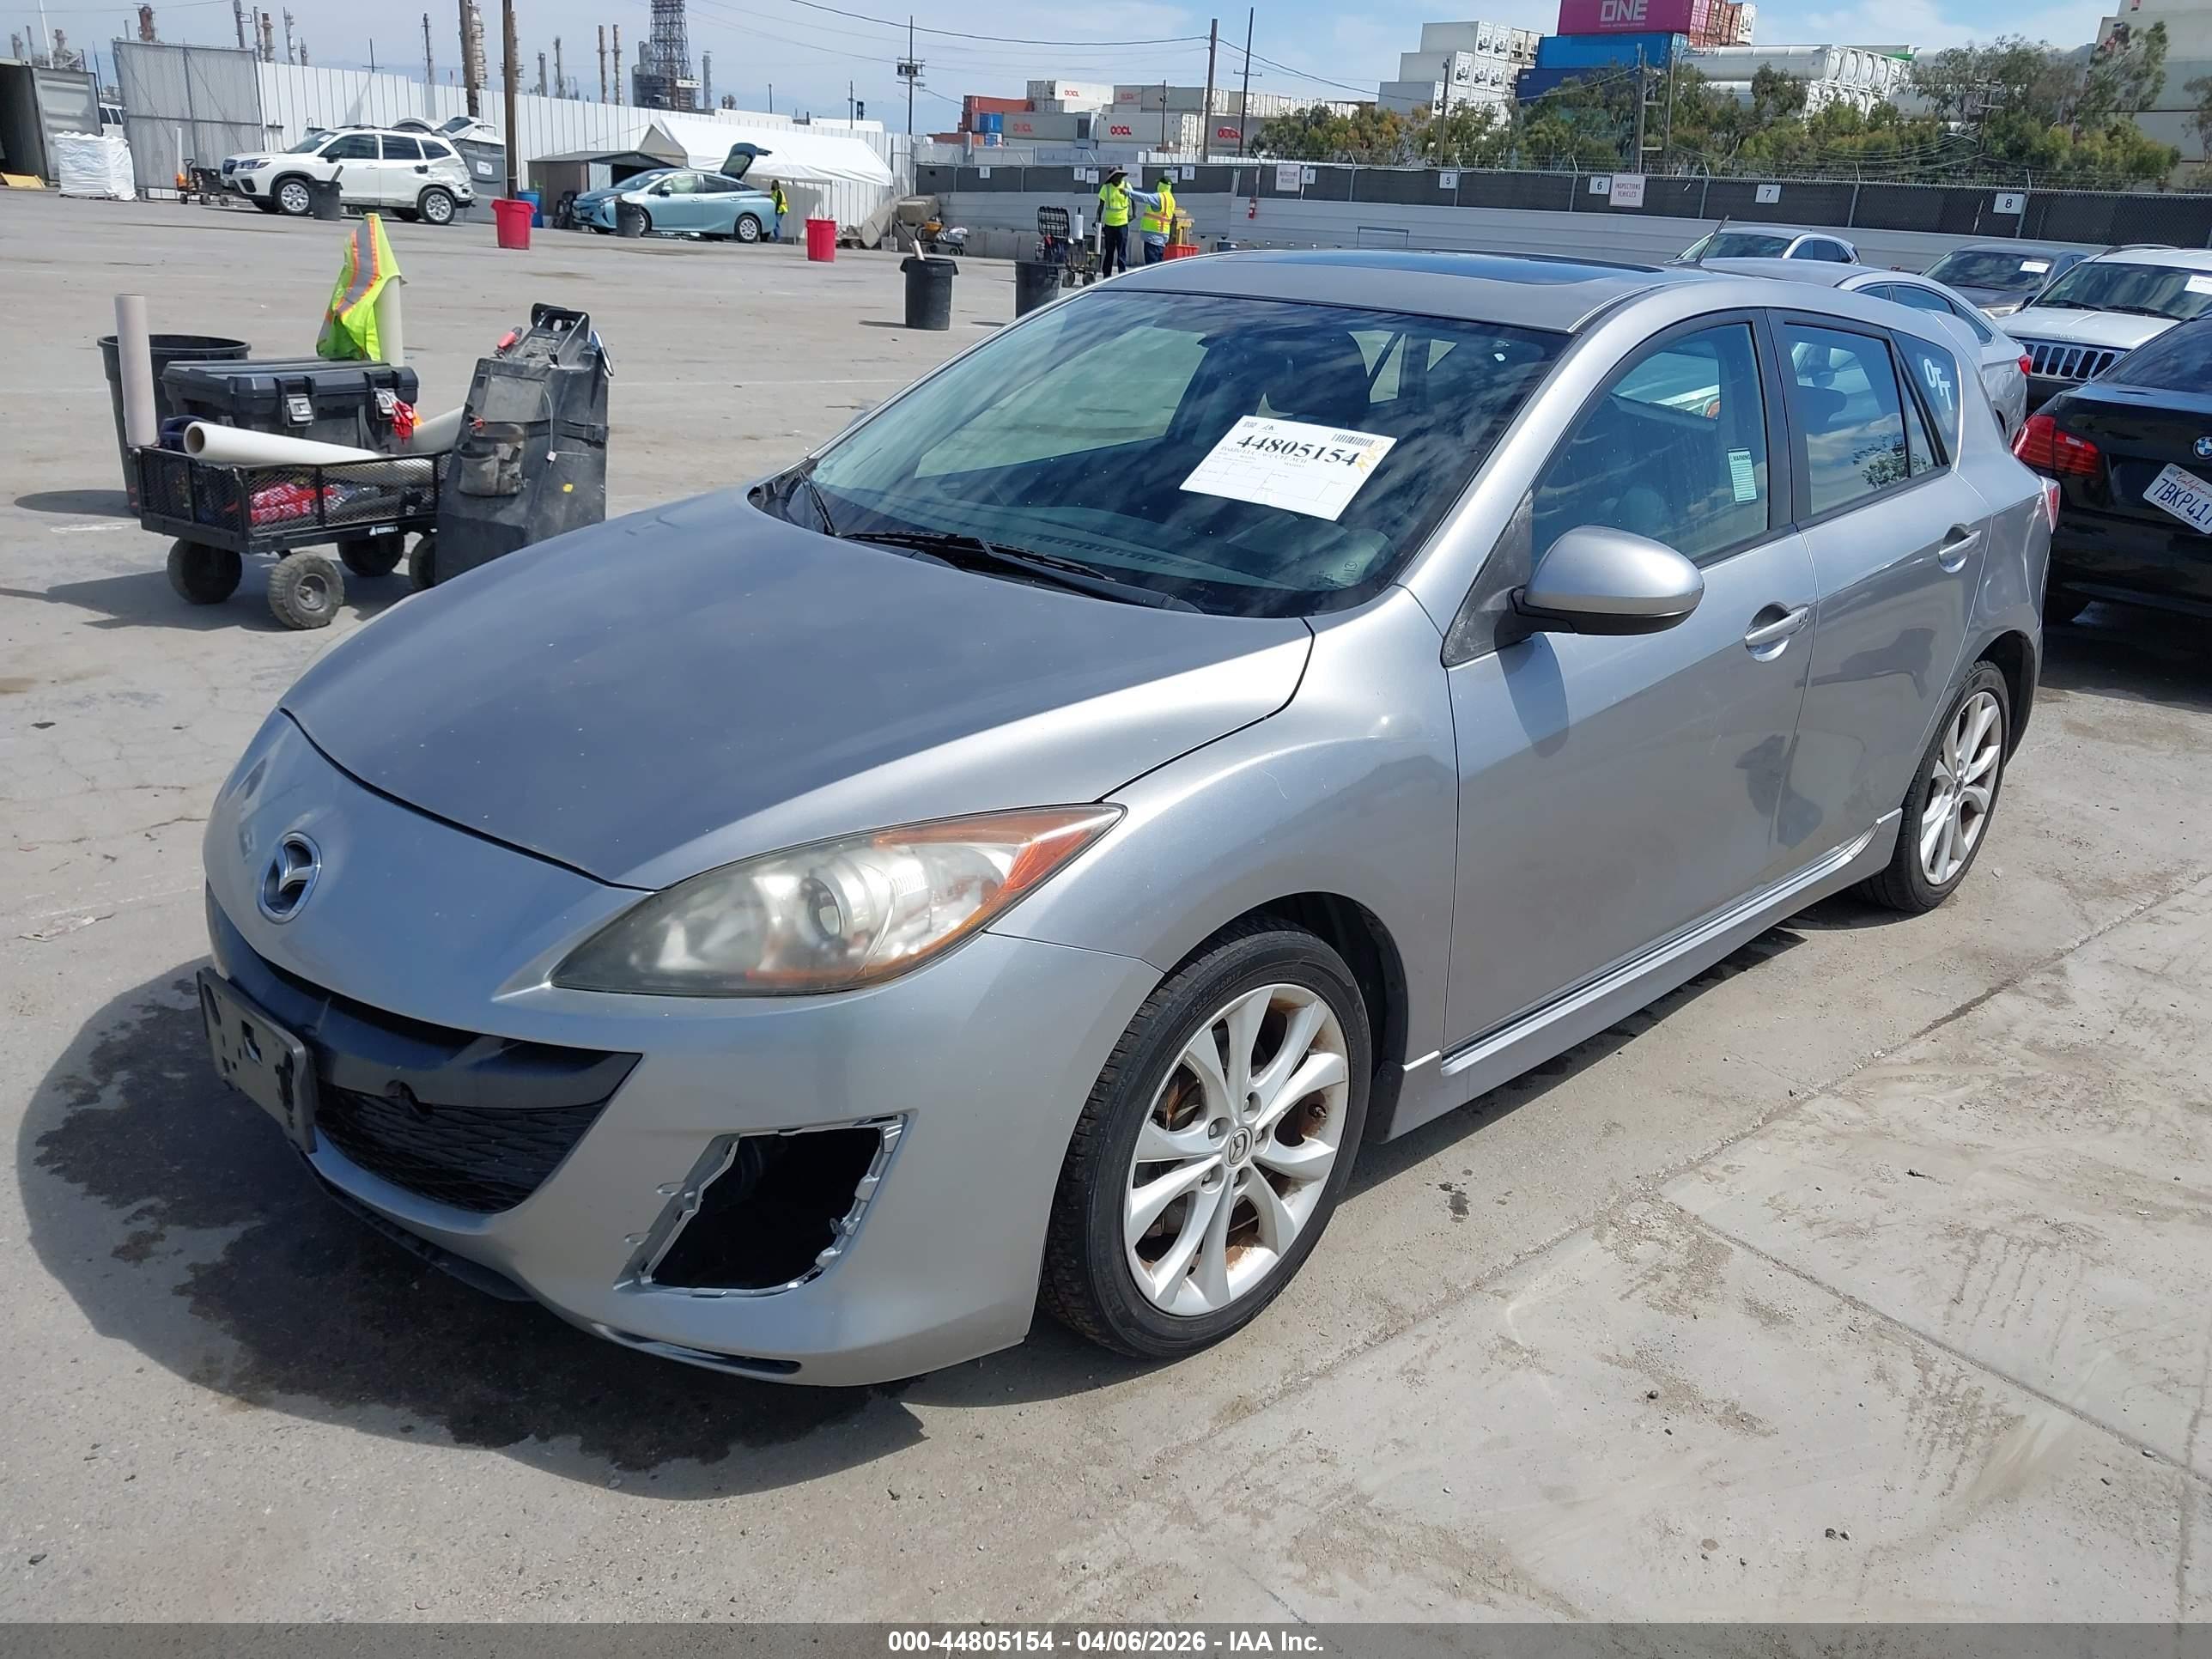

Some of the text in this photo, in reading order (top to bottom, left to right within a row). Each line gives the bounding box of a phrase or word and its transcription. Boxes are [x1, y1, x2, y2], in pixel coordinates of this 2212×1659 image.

[1600, 0, 1649, 21] ONE
[1110, 125, 1132, 136] OOCL
[1597, 181, 1602, 190] 6
[1765, 189, 1772, 198] 7
[2005, 198, 2013, 209] 8
[1237, 434, 1361, 466] 44805154
